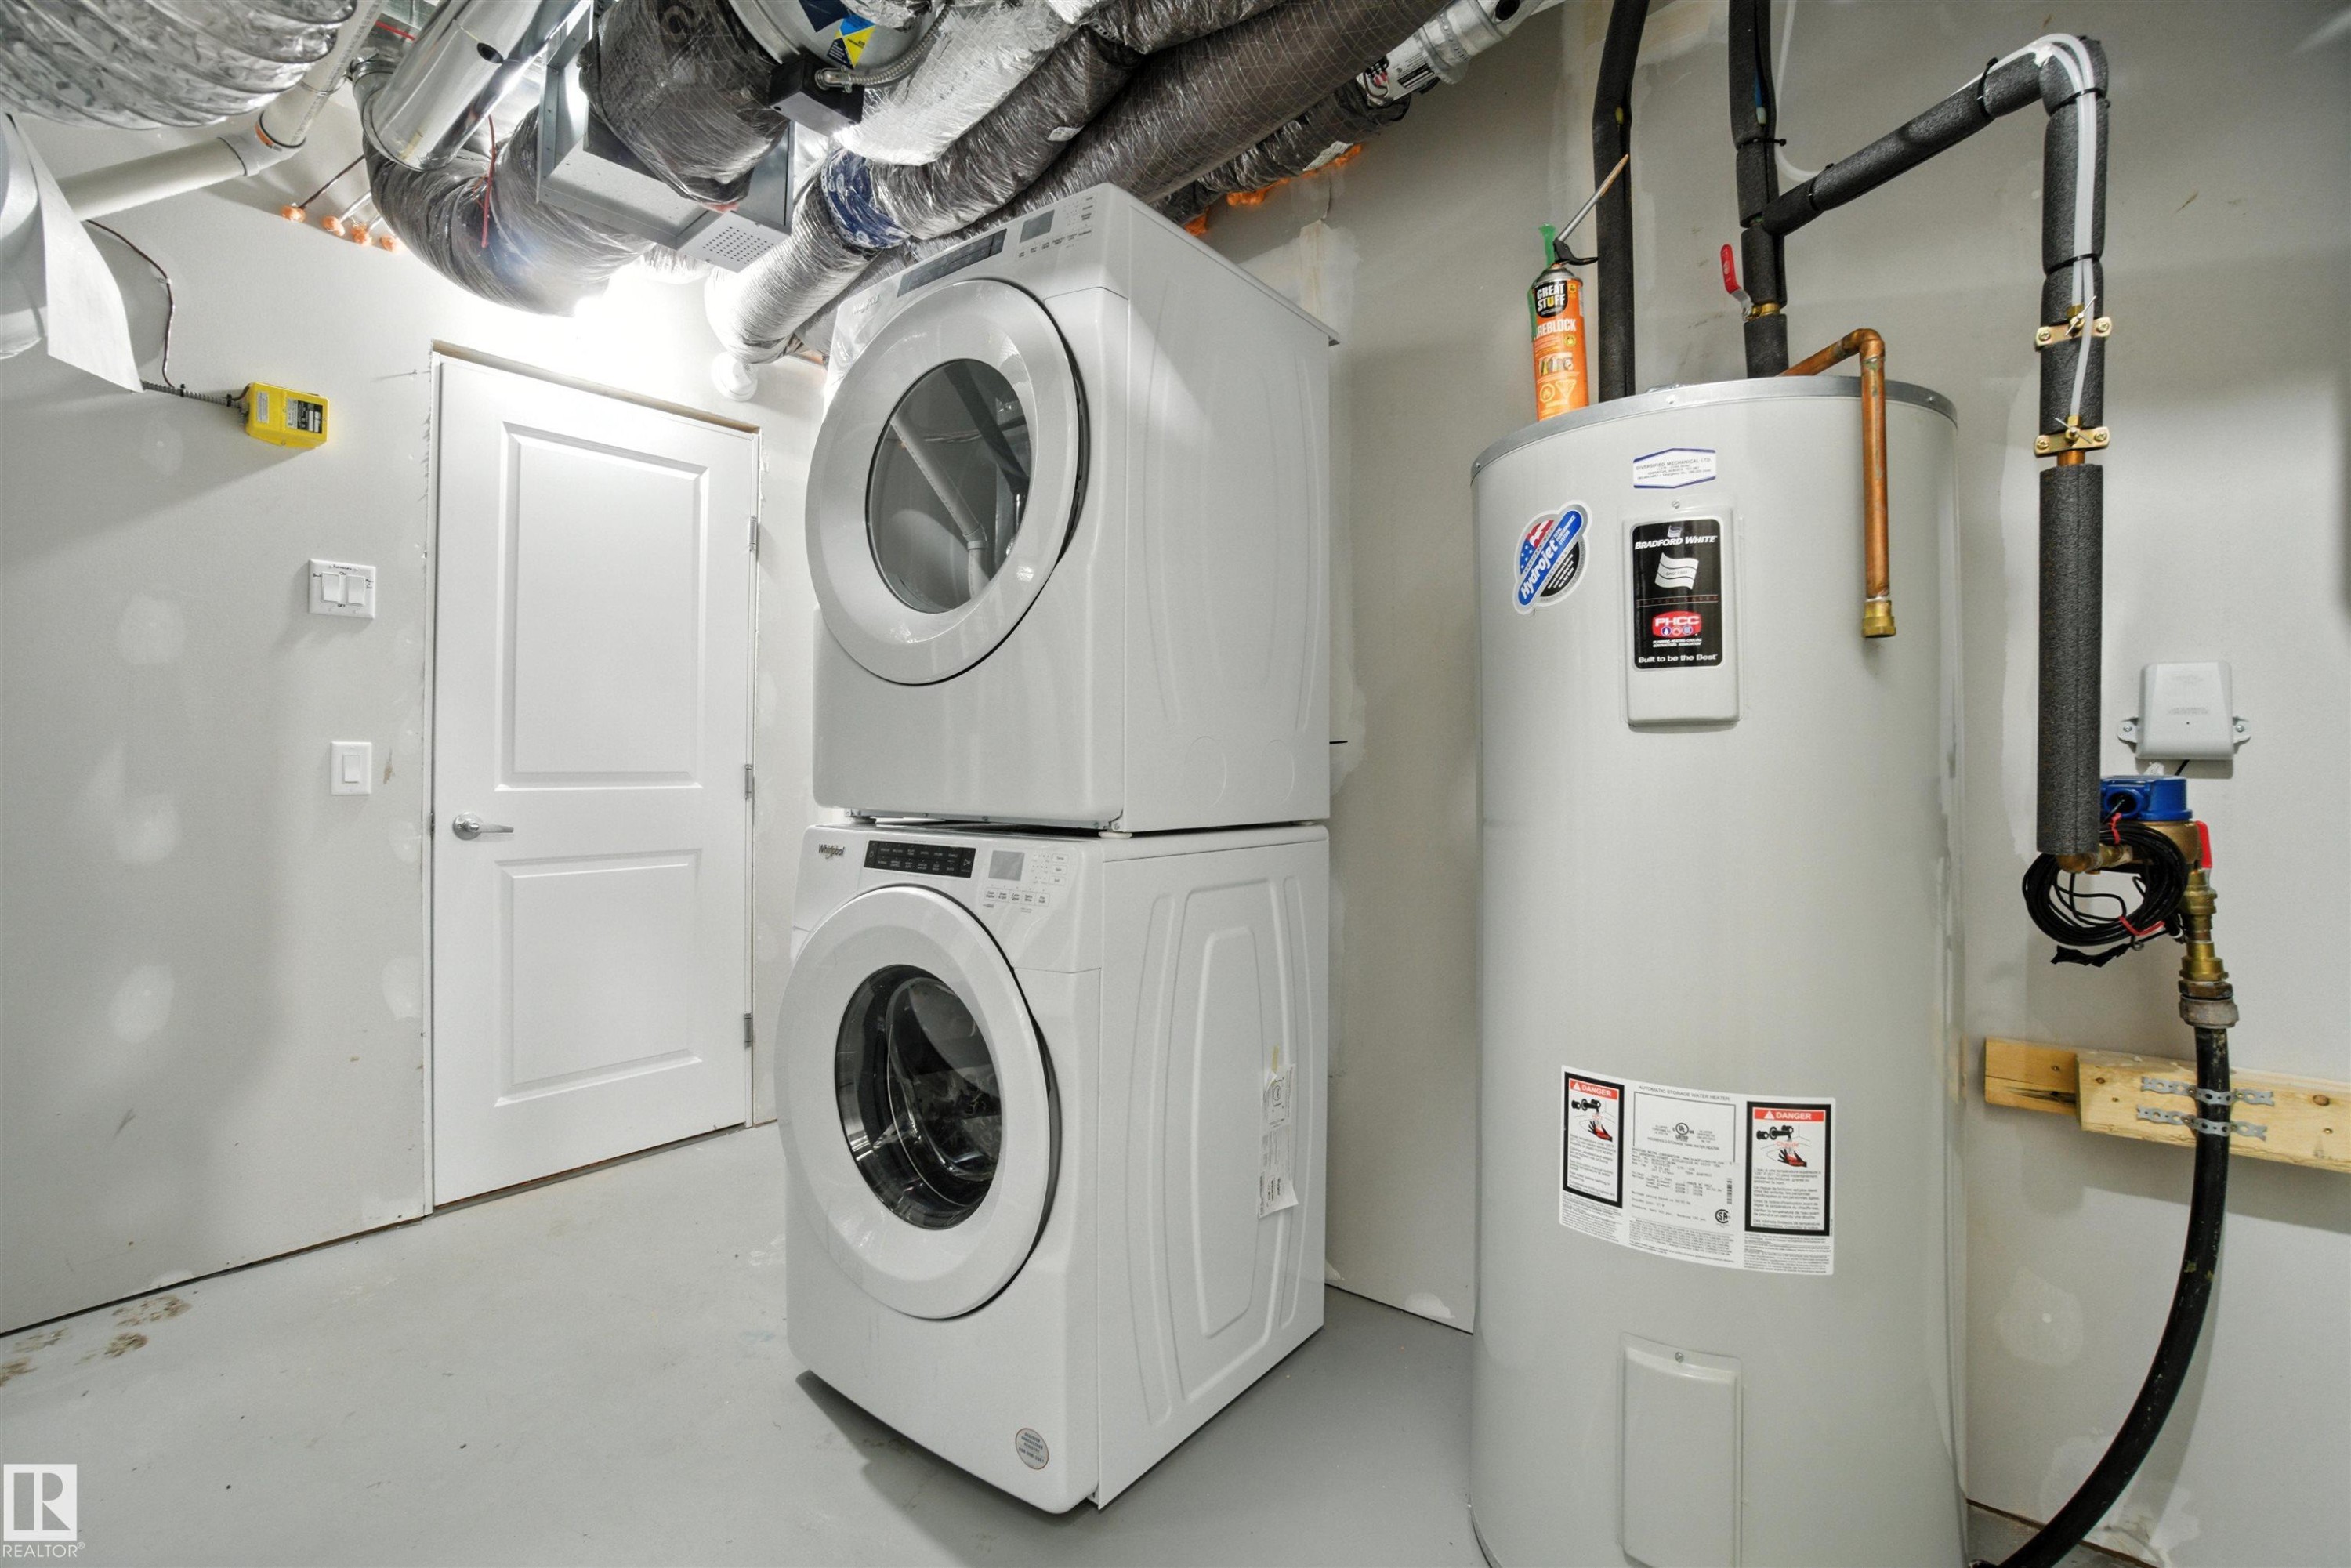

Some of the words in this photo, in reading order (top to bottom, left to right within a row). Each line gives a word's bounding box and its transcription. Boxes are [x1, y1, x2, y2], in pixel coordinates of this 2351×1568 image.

[1536, 283, 1565, 300] GREAT
[1537, 294, 1566, 312] STUFF
[1635, 538, 1683, 550] BRADFORD
[1520, 539, 1559, 599] Hydrojet
[1655, 616, 1700, 627] PHCC
[819, 844, 845, 857] Whirlpool
[1581, 1084, 1612, 1097] DANGER
